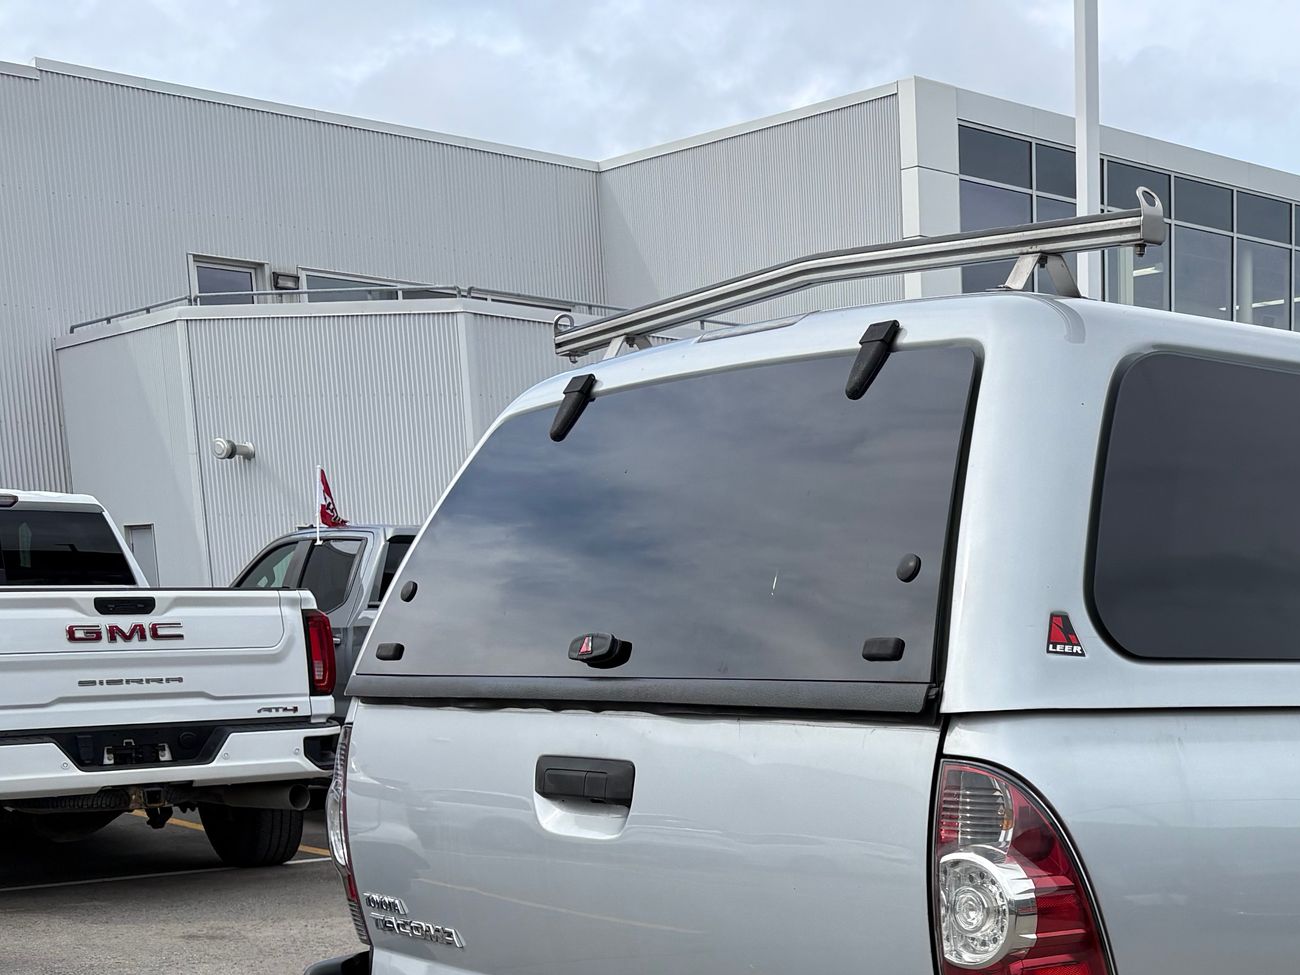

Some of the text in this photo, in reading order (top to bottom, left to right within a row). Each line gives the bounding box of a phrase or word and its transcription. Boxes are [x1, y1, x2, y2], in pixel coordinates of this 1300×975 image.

[65, 622, 184, 643] GMC
[1048, 643, 1082, 653] LEER
[77, 676, 184, 687] SIERRA
[257, 705, 298, 714] AT4
[363, 892, 409, 915] TOYOTA
[369, 911, 466, 948] TACOMA
